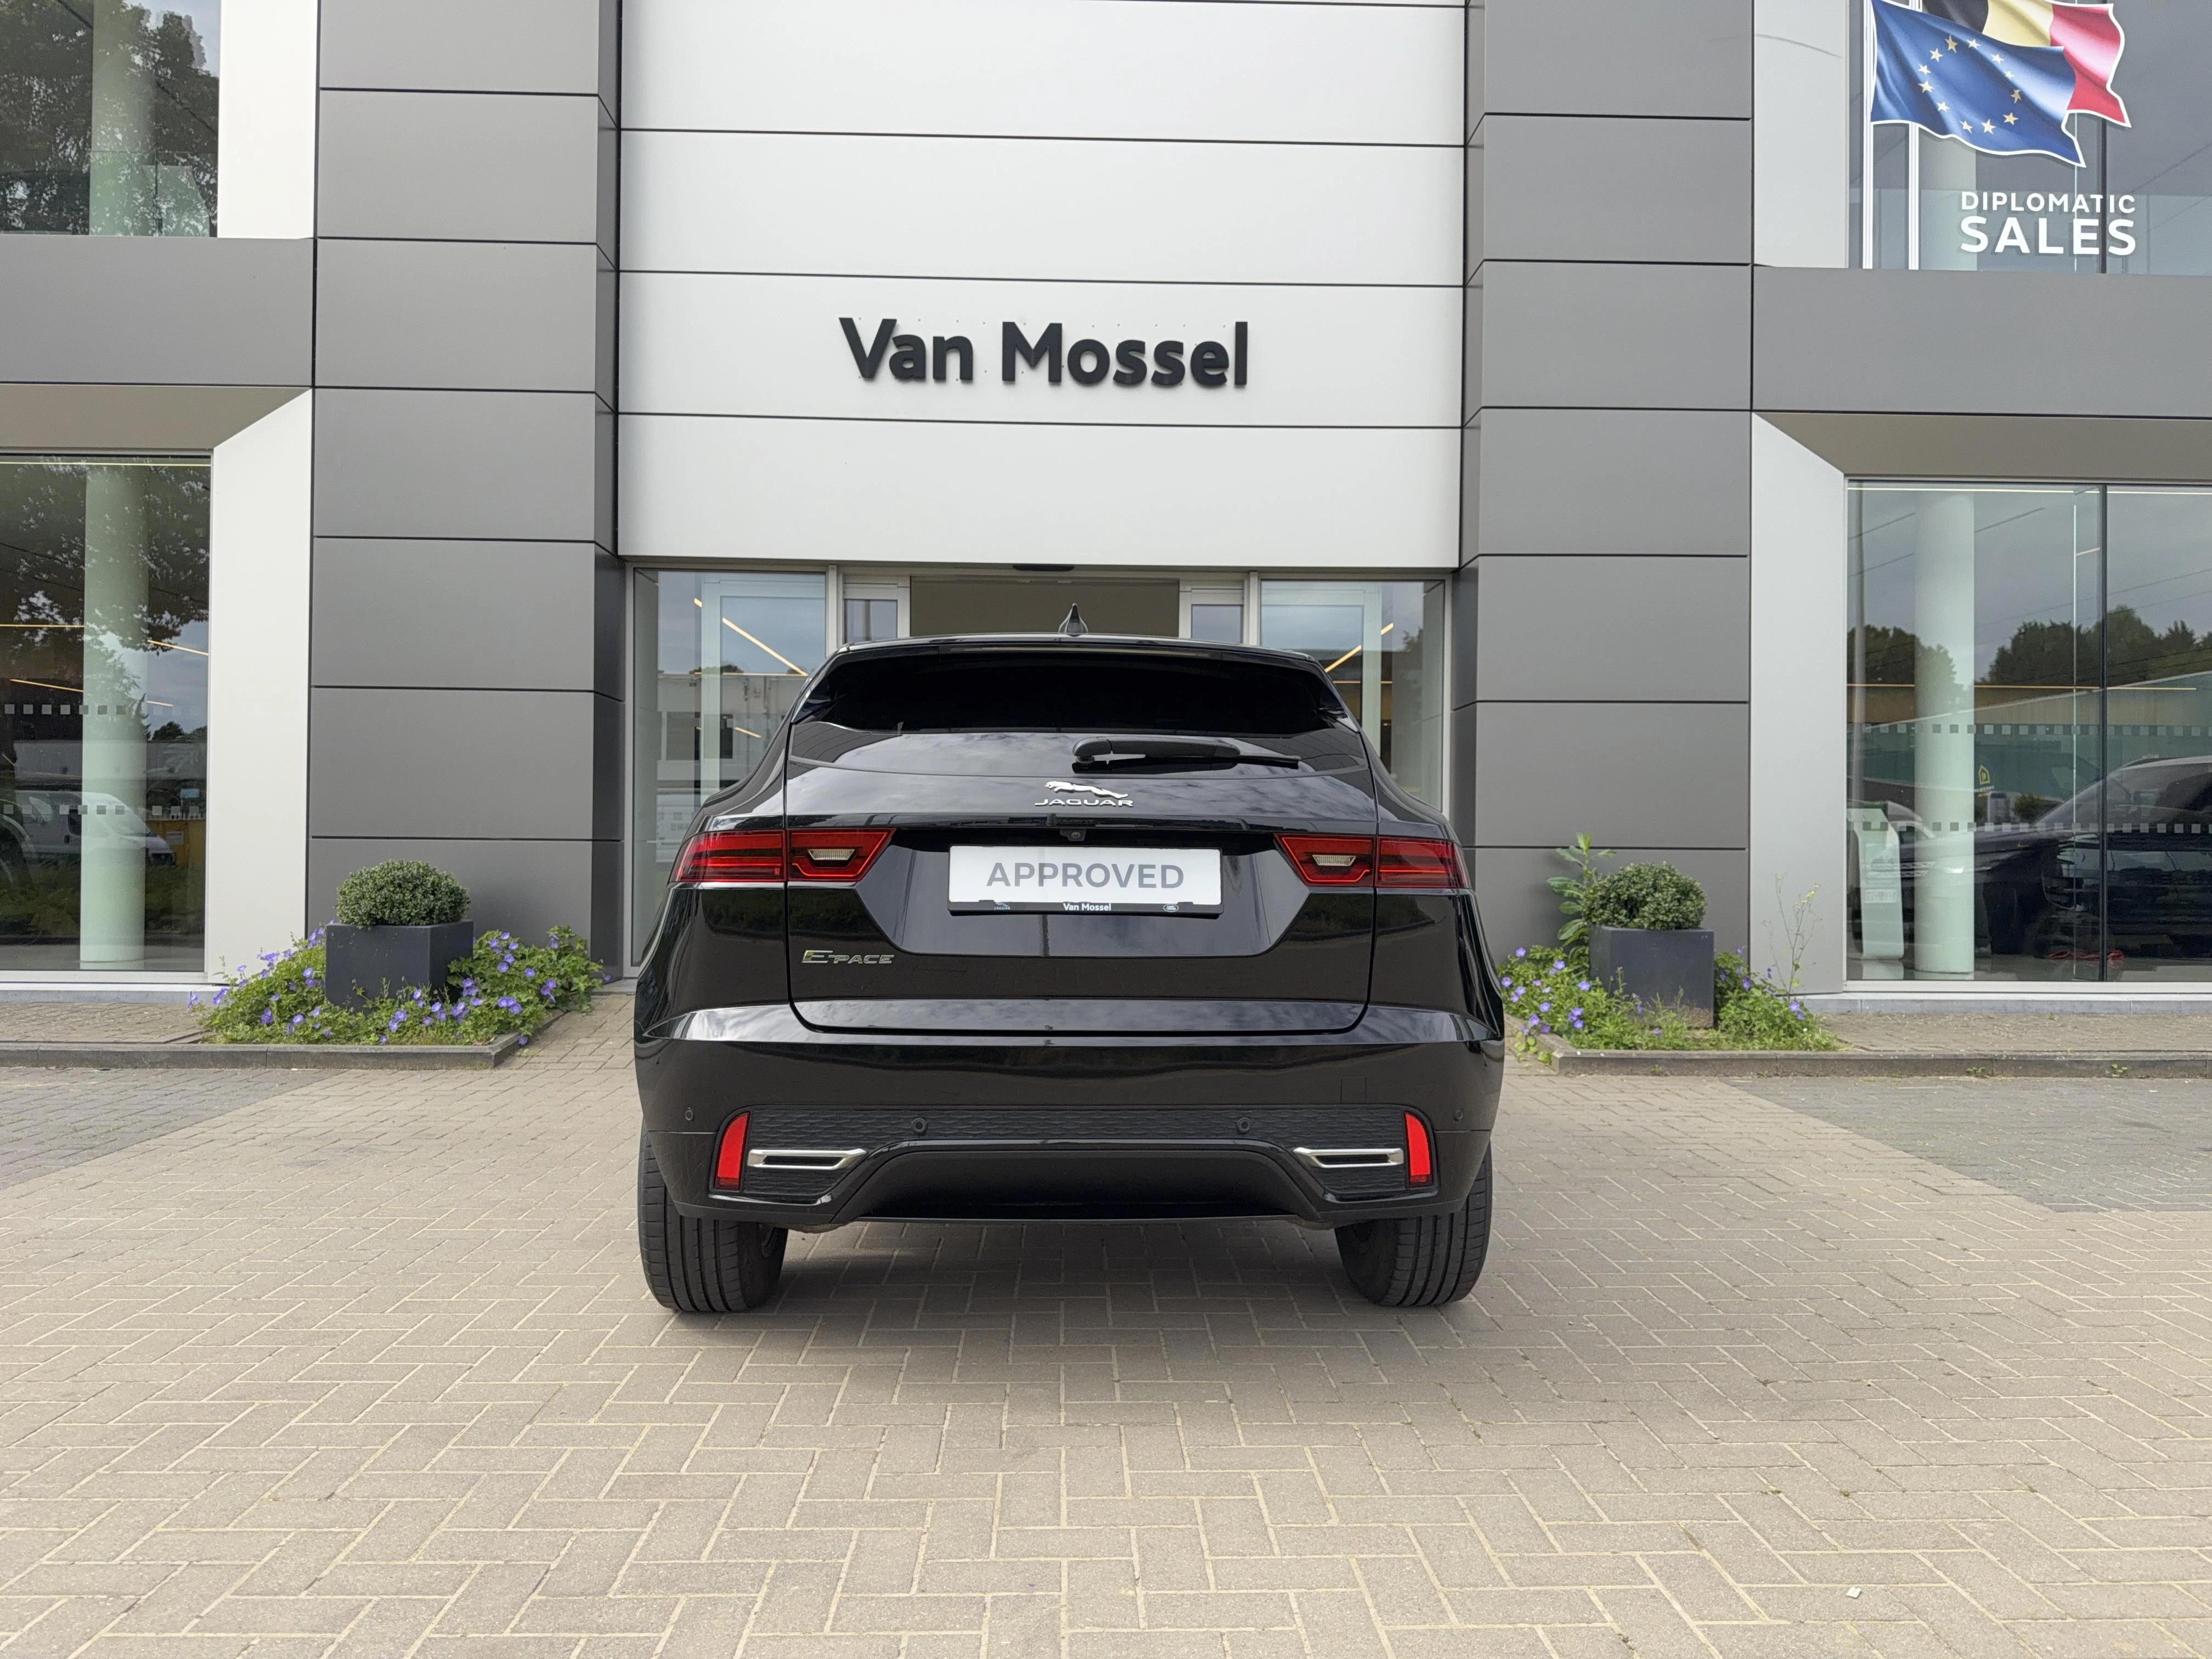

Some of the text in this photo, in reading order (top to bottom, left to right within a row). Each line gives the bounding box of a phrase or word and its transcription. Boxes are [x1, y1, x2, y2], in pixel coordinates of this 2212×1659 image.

[1961, 191, 2136, 214] DIPLOMATIC
[1960, 216, 2136, 256] SALES
[838, 317, 1249, 386] Van Mossel
[1034, 799, 1134, 807] JAGUAR
[986, 862, 1184, 889] APPROVED
[1063, 902, 1111, 911] Van Mossel
